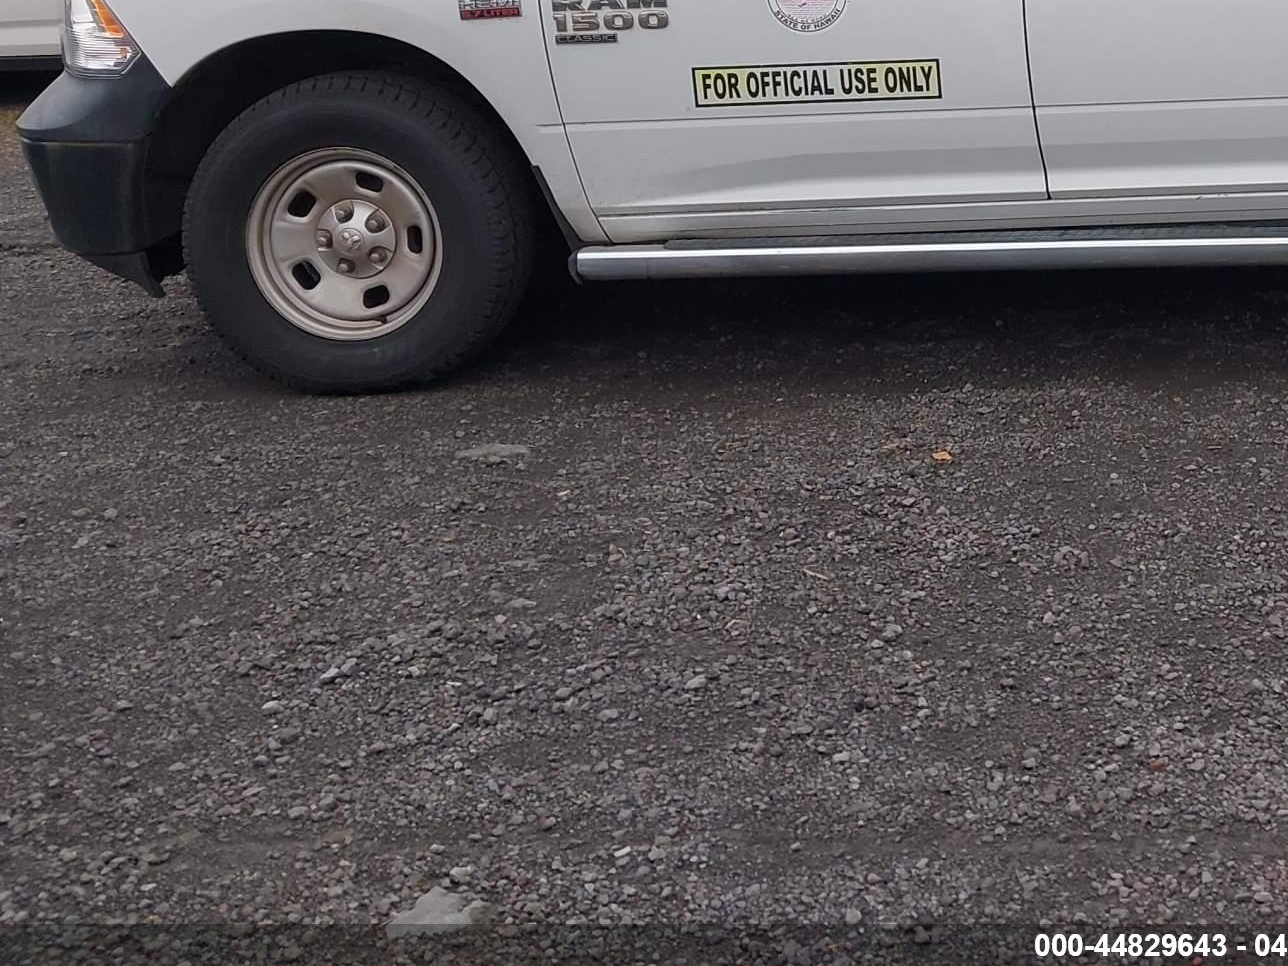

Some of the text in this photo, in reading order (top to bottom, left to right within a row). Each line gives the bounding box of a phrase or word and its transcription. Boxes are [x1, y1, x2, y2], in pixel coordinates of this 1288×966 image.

[553, 10, 669, 32] 1500
[775, 10, 799, 29] STATE
[814, 8, 841, 30] HAWAII
[556, 34, 618, 44] CLASSIC
[701, 65, 933, 99] FOR OFFICIAL USE ONLY
